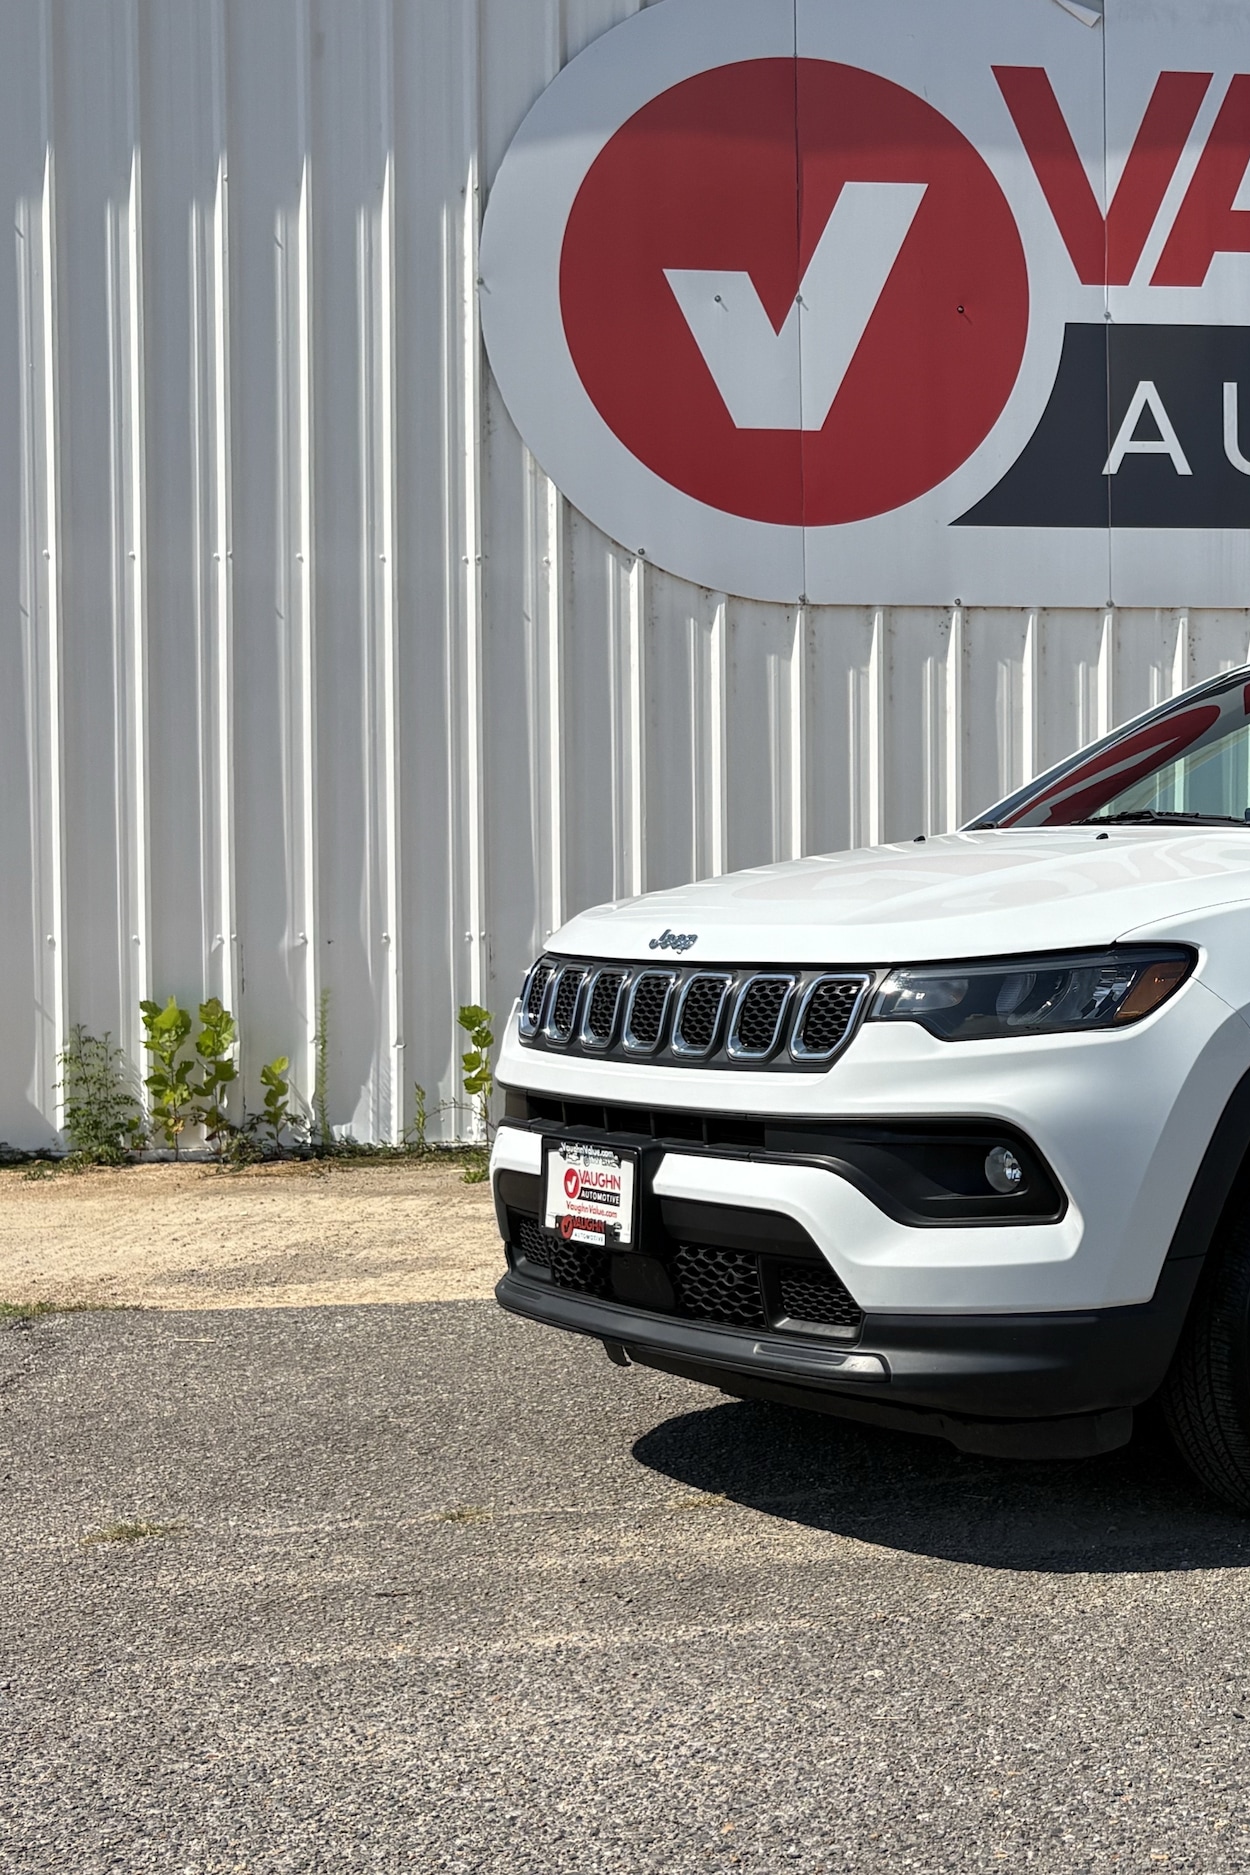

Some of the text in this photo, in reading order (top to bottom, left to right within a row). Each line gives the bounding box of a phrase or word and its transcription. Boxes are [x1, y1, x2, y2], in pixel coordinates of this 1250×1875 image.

[648, 929, 698, 954] Jeep
[578, 1169, 621, 1190] VAUGHN
[581, 1190, 619, 1204] AUTOMOTIVE
[566, 1200, 617, 1218] VaughnValue.com
[573, 1215, 606, 1232] VAUGHN
